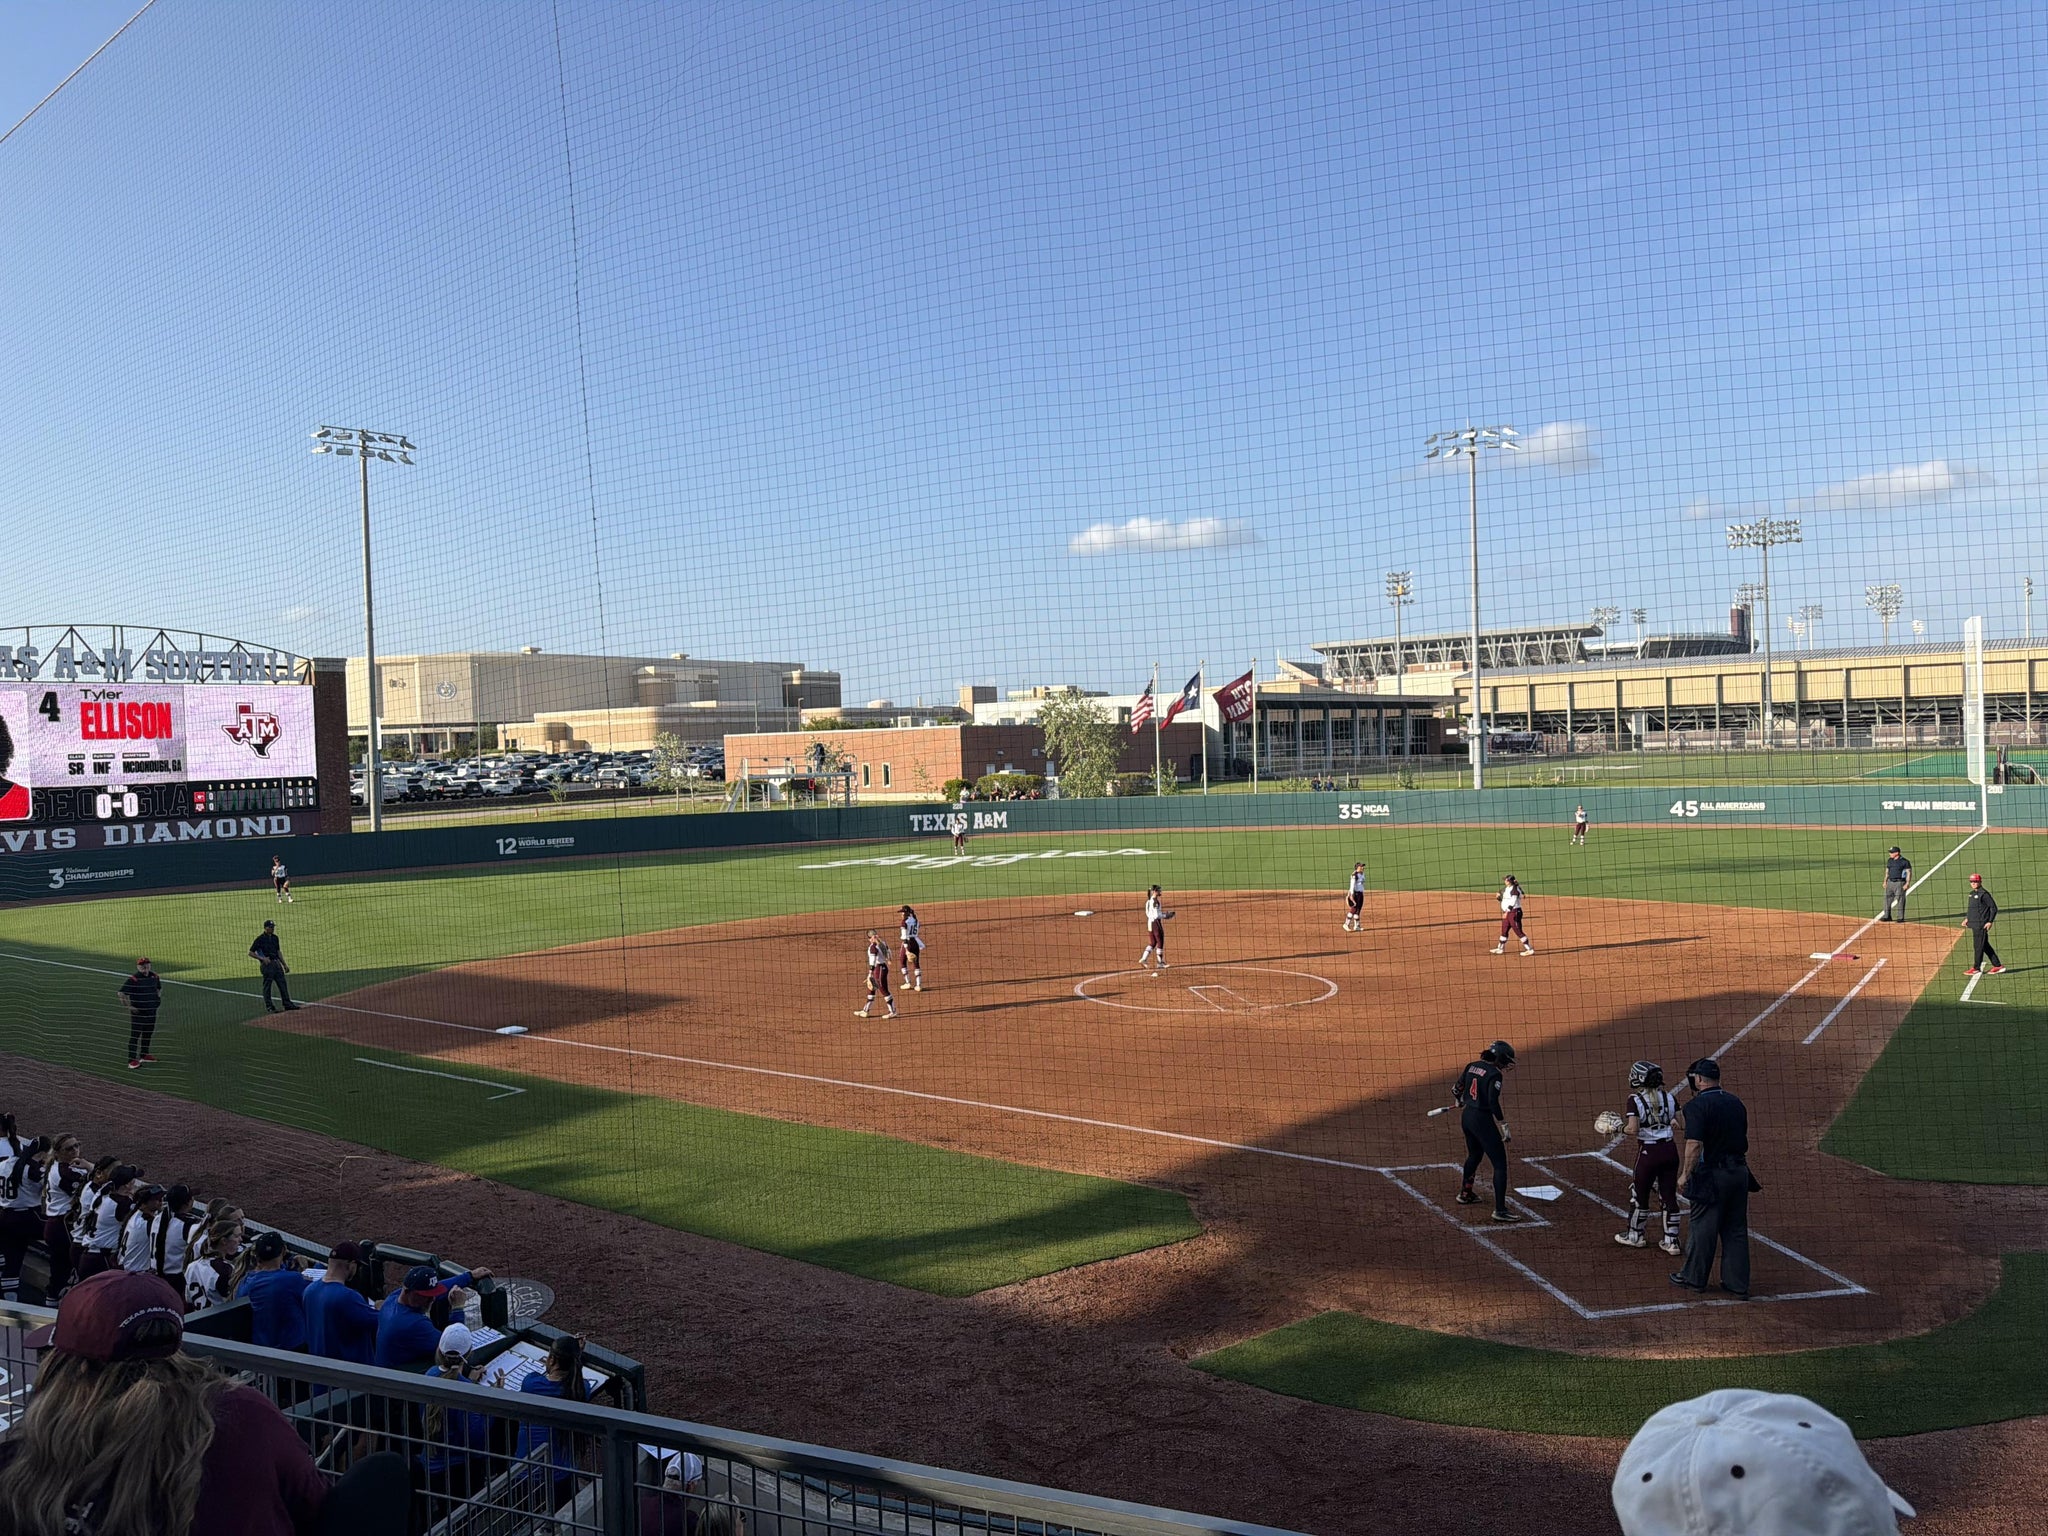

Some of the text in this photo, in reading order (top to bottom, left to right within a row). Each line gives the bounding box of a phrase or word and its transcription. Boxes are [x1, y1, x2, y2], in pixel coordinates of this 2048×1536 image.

[54, 647, 134, 680] A&M
[145, 650, 304, 682] SOFTBALL
[80, 689, 123, 701] Tyler
[39, 691, 61, 722] 4
[80, 702, 173, 740] ELLISON
[69, 762, 85, 775] SR
[93, 762, 111, 774] INF
[172, 759, 182, 771] GA
[96, 793, 138, 818] 0-0
[1338, 804, 1362, 819] 35
[1363, 804, 1390, 813] NCAA
[1669, 800, 1699, 817] 45
[1700, 802, 1766, 811] ALL AMERICANS
[1904, 801, 1930, 810] MAN
[1932, 801, 1976, 810] MOBILE
[909, 811, 1008, 831] TEXAS A&M
[0, 815, 292, 853] VIS DIAMOND
[518, 839, 546, 847] WORLD
[546, 837, 575, 845] SERIES
[496, 838, 517, 855] 12
[48, 868, 65, 889] 3
[65, 868, 134, 881] CHAMPIONSHIPS
[1470, 1078, 1477, 1100] 4
[119, 1309, 146, 1328] TEXAS
